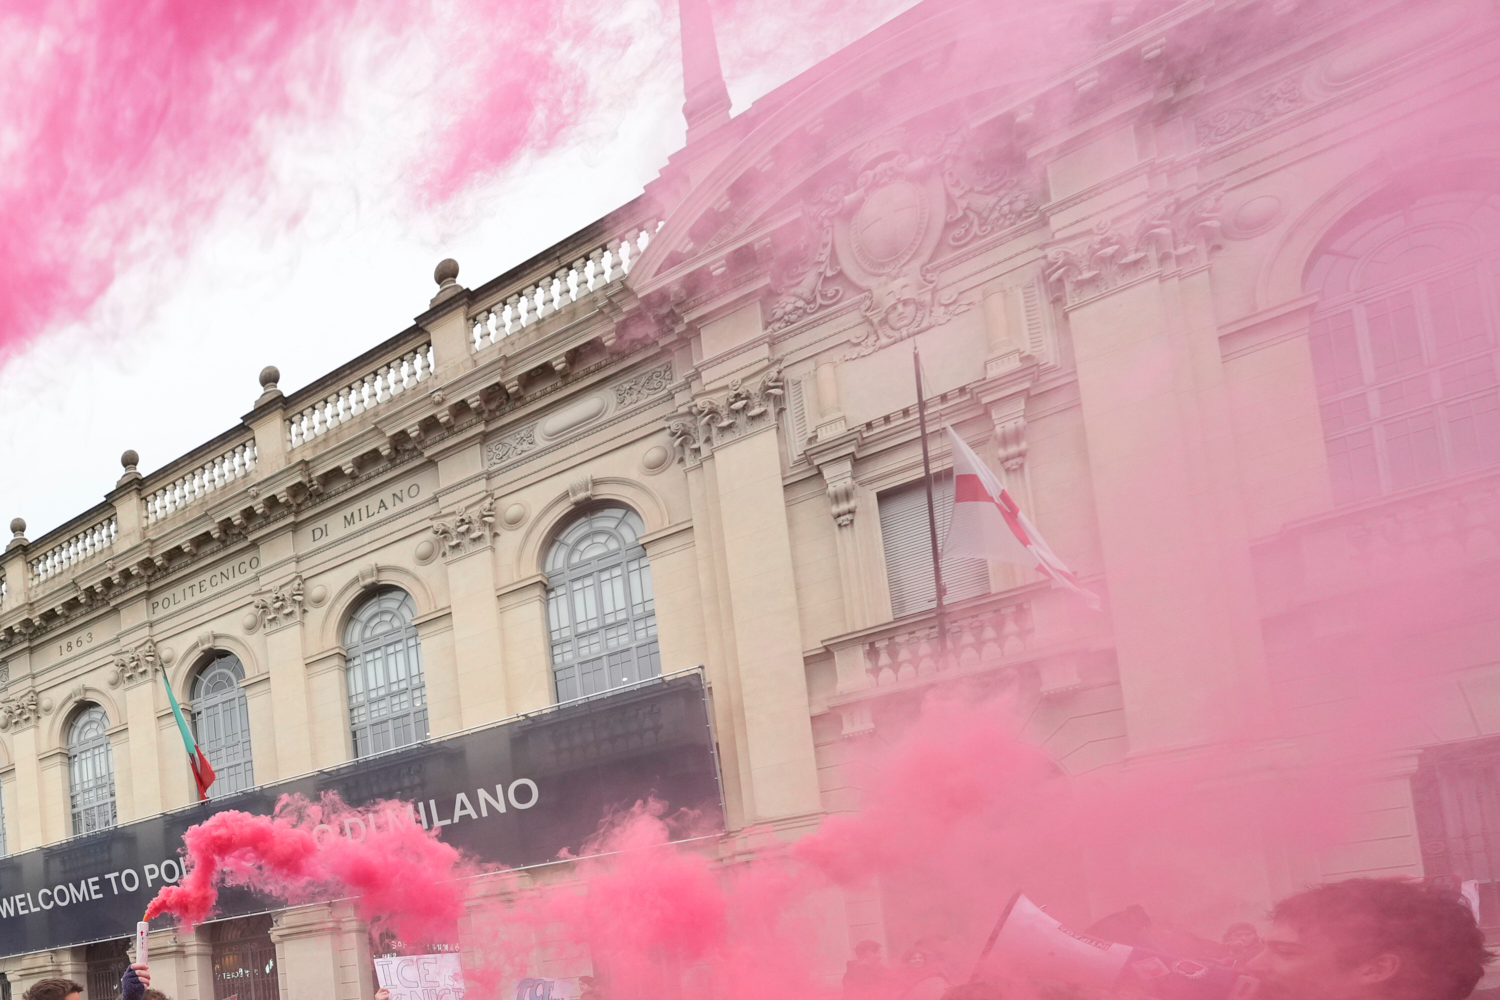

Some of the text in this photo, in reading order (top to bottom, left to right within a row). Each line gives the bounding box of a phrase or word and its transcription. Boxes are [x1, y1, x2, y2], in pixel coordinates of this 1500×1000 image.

[151, 483, 421, 615] POLITECNICO DI MILANO
[58, 631, 94, 656] 1863
[104, 868, 140, 895] TO
[377, 958, 440, 989] ICE
